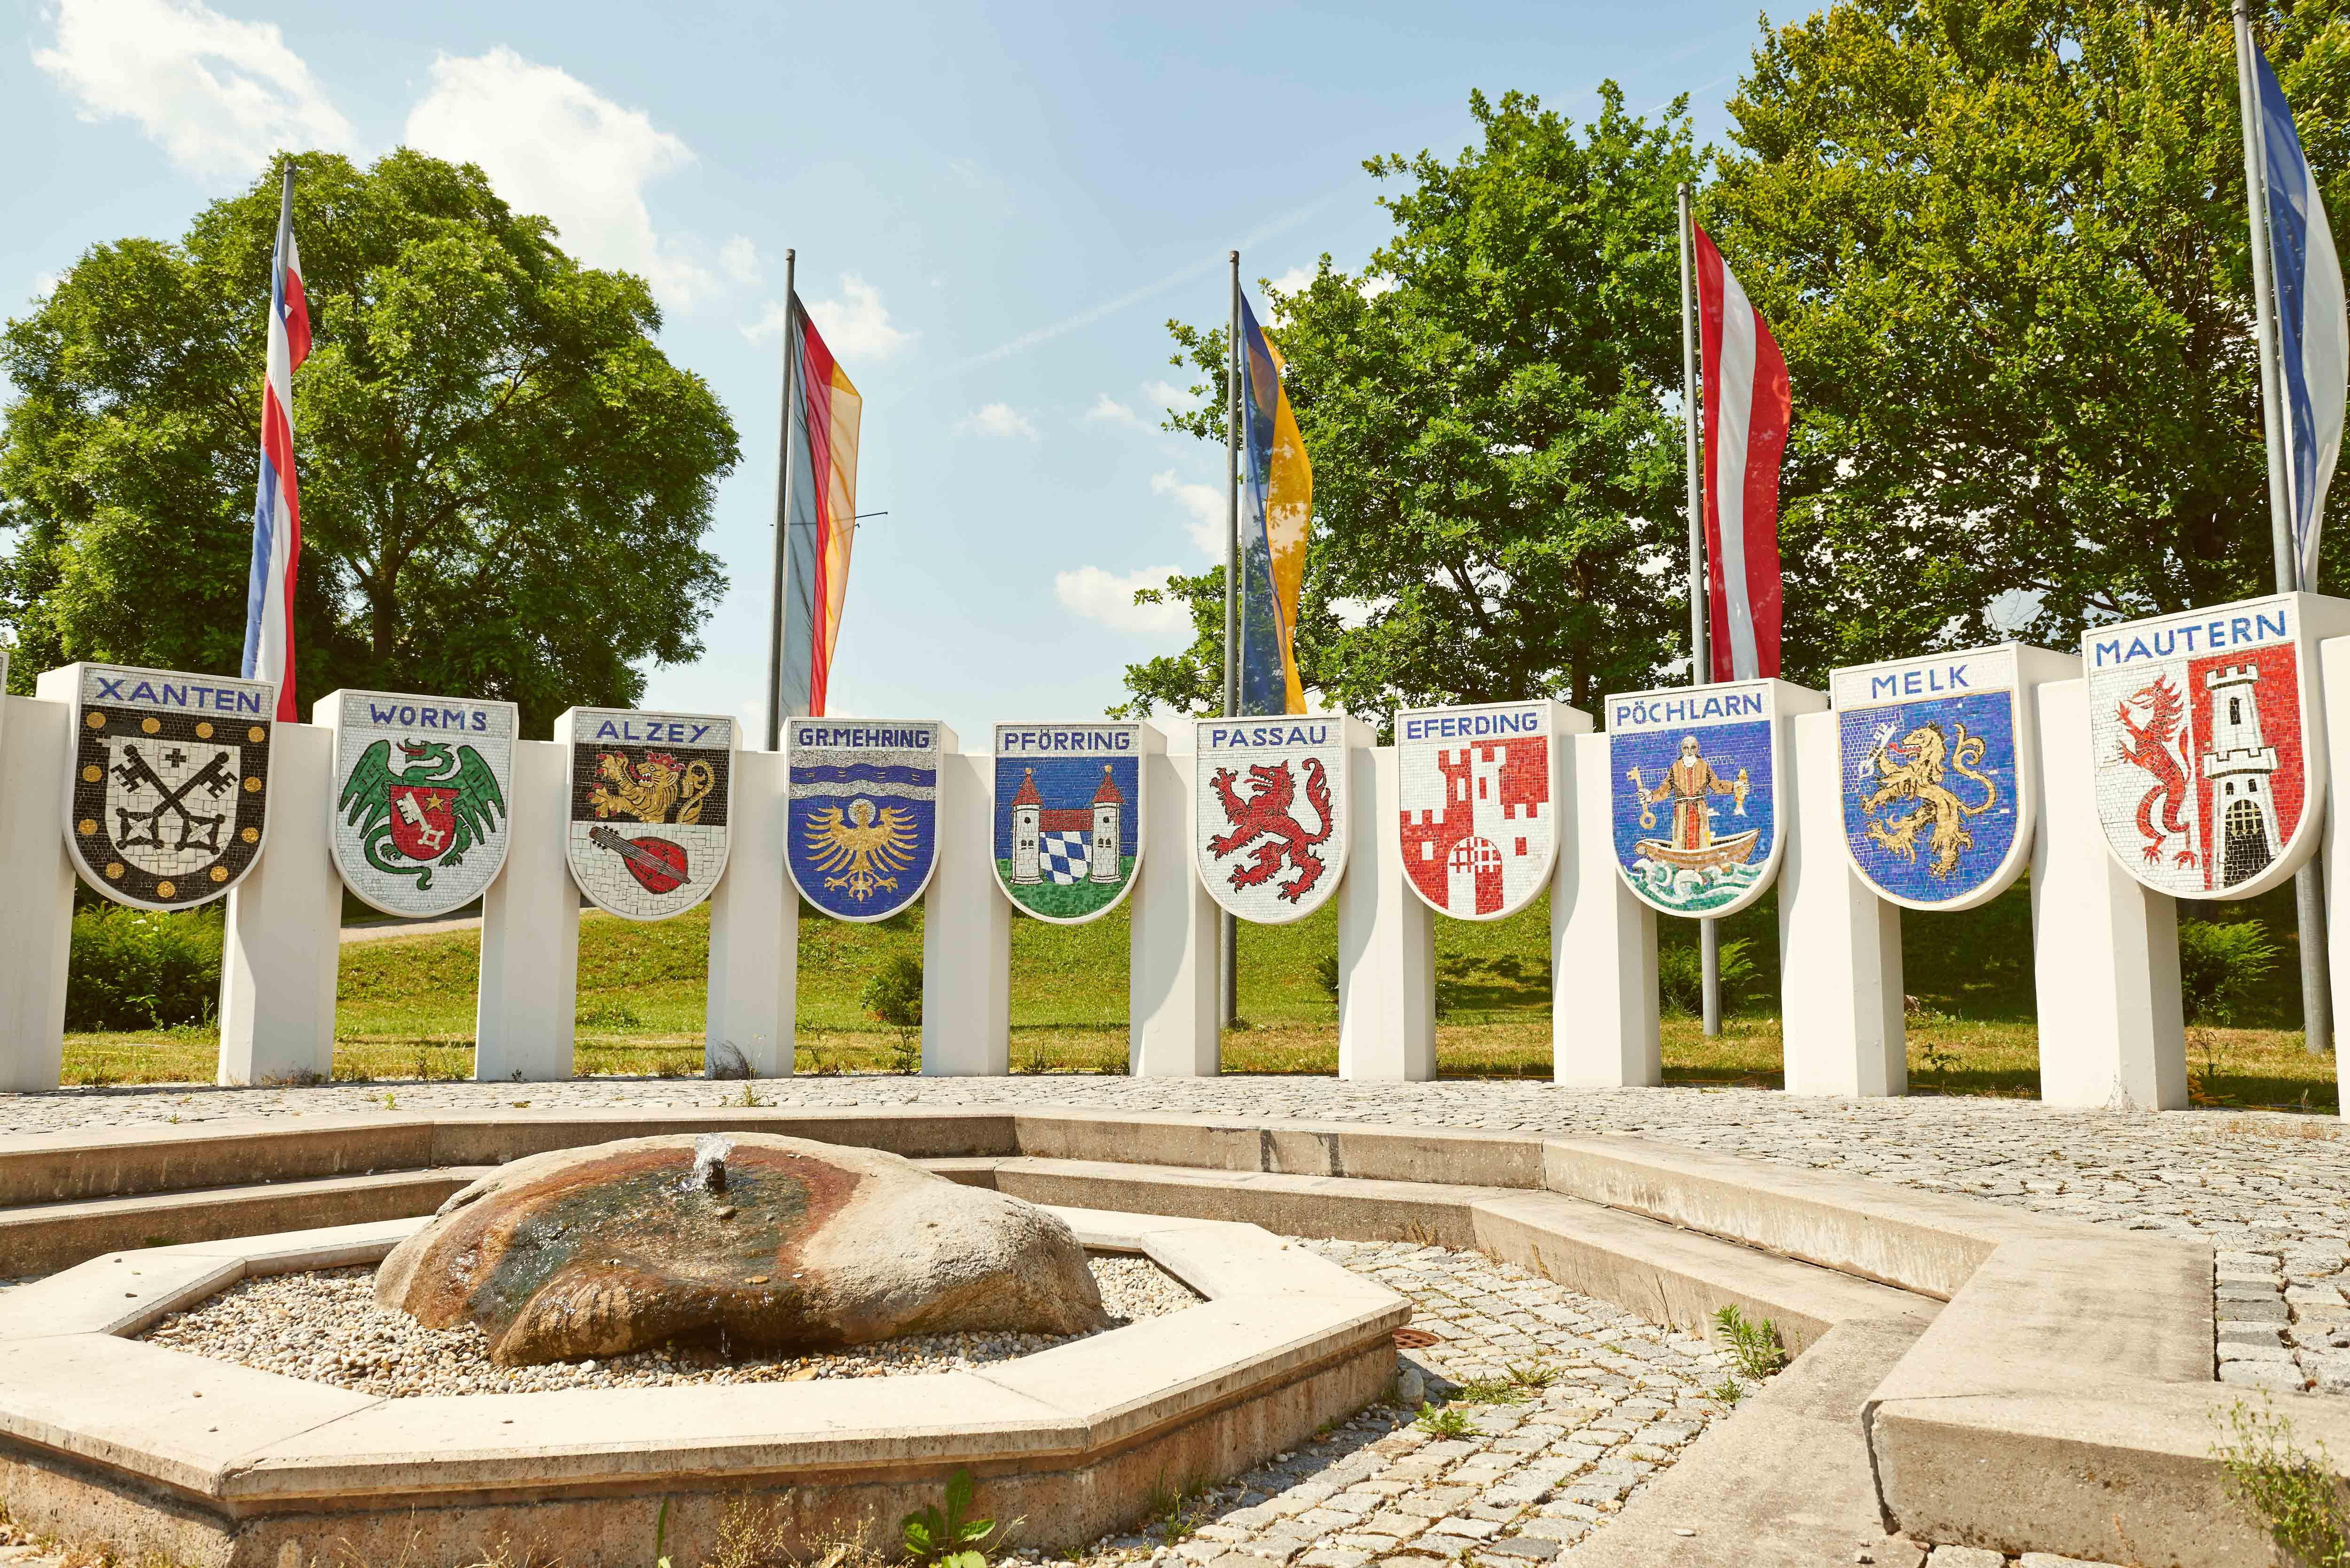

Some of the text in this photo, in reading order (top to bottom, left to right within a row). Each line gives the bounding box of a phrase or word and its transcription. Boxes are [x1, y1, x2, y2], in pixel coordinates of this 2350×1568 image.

[2096, 610, 2286, 667] MAUTERN
[96, 677, 260, 713] XANTEN
[1872, 664, 1970, 700] MELK
[369, 703, 486, 732] WORMS
[1617, 693, 1762, 726] PÖCHLARN
[595, 720, 711, 744] ALZEY
[799, 728, 930, 749] GR.MEHRING
[1004, 728, 1130, 750] PFÖRRING
[1212, 725, 1326, 748] PASSAU
[1407, 712, 1538, 740] EFERDING
